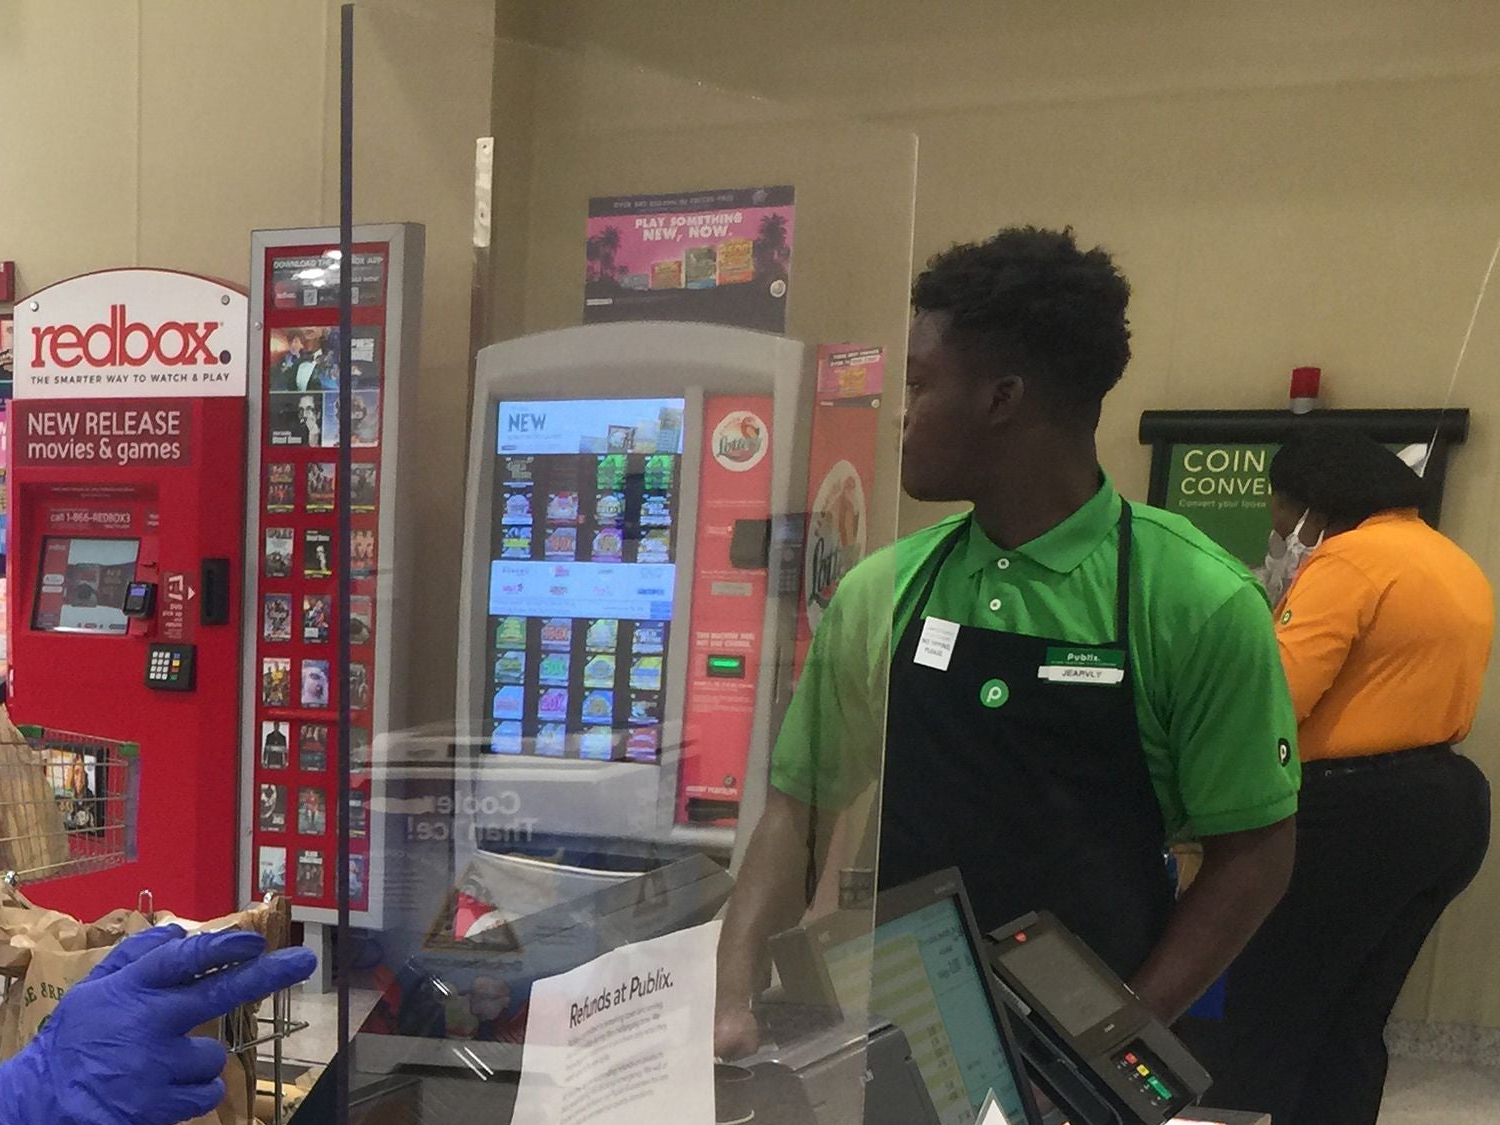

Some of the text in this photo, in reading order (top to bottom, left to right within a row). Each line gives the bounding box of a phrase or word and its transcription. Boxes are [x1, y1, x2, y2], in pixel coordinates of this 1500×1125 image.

[635, 211, 743, 229] PLAY SOMETHING
[643, 226, 683, 242] NEW,
[31, 372, 230, 384] THE SMARTER WAY TO WATCH & PLAY
[28, 410, 181, 436] NEW RELEASE
[507, 412, 547, 433] NEW
[28, 437, 181, 466] movies & games
[1183, 448, 1266, 473] COIN
[569, 966, 674, 1029] Refunds at Publix.
